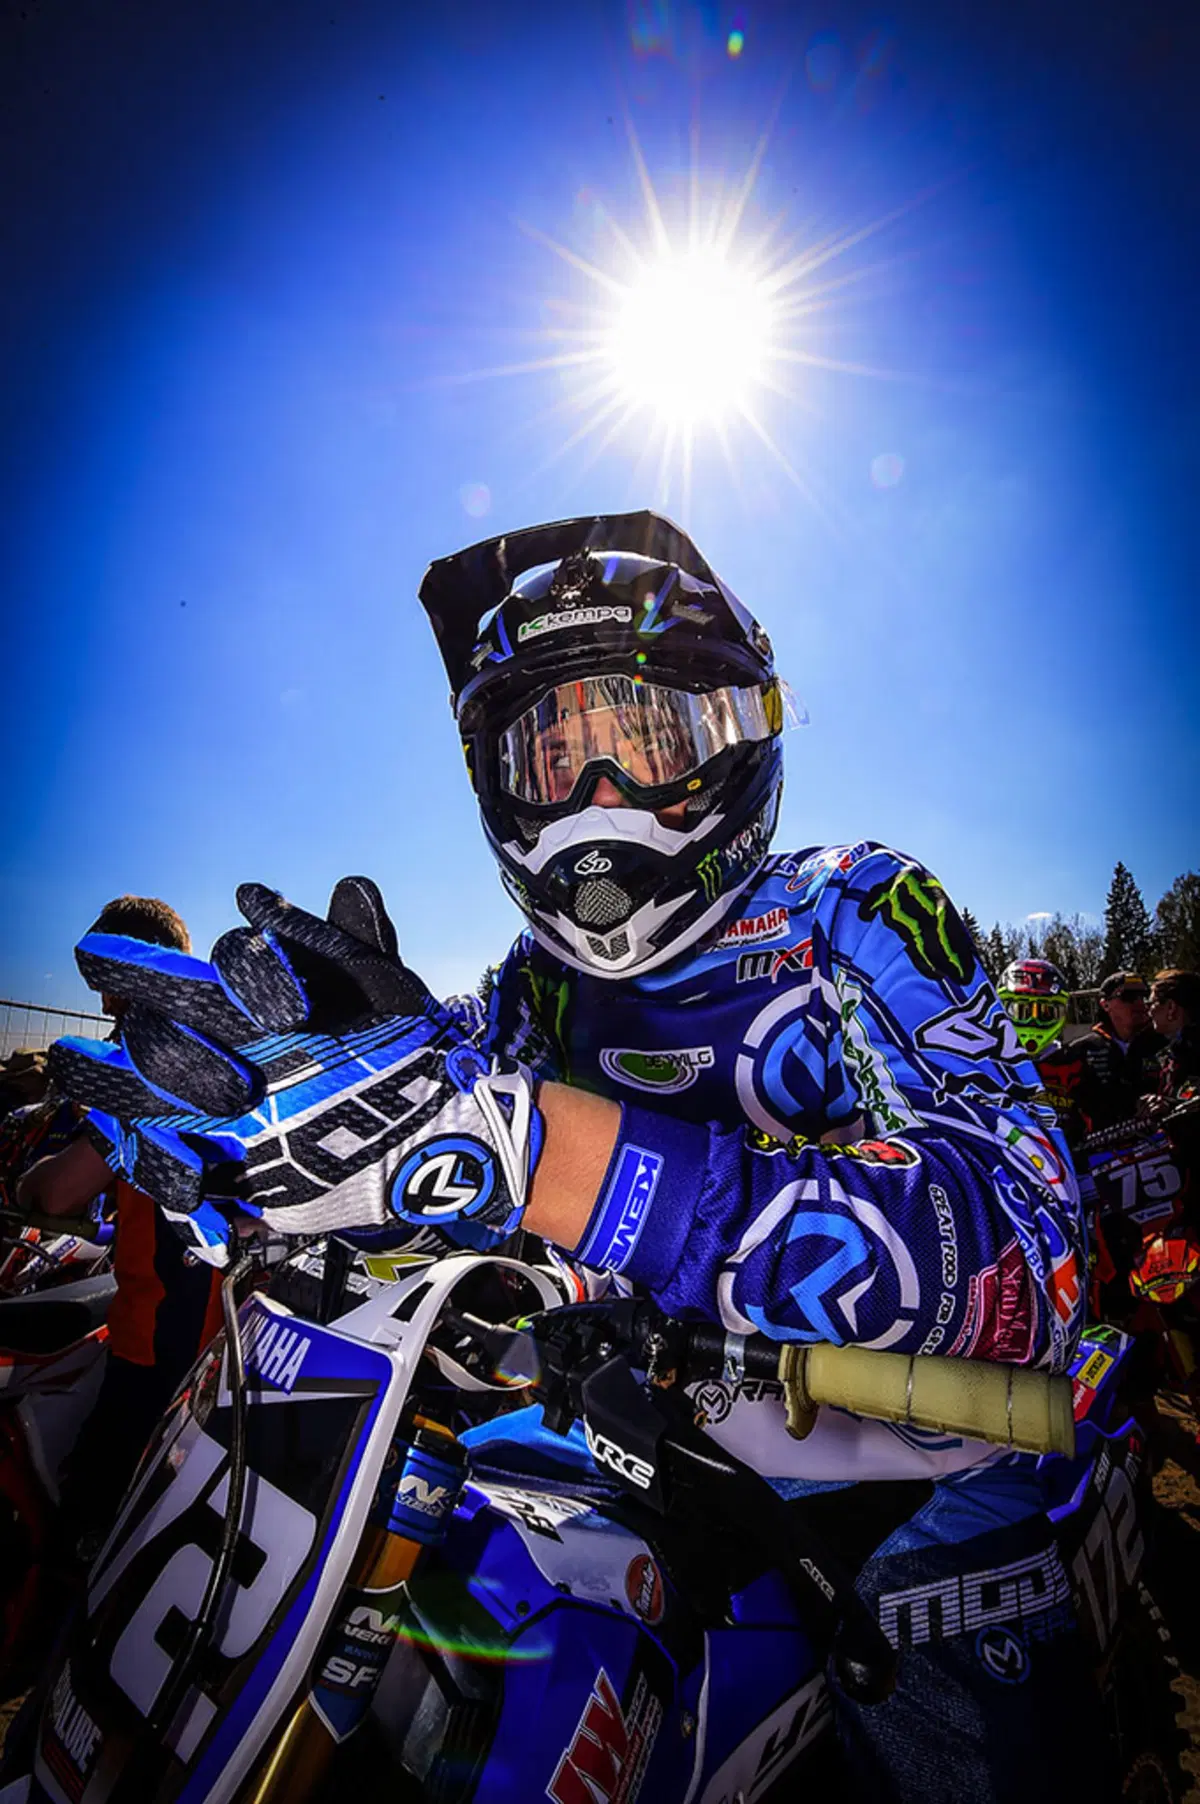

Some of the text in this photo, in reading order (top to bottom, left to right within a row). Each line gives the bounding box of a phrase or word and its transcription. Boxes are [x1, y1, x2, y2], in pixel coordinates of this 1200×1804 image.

[724, 907, 789, 938] AMAHA
[1108, 1154, 1181, 1210] 75
[941, 1242, 957, 1288] FOOD
[936, 1293, 956, 1324] FOR
[321, 1655, 382, 1688] SF
